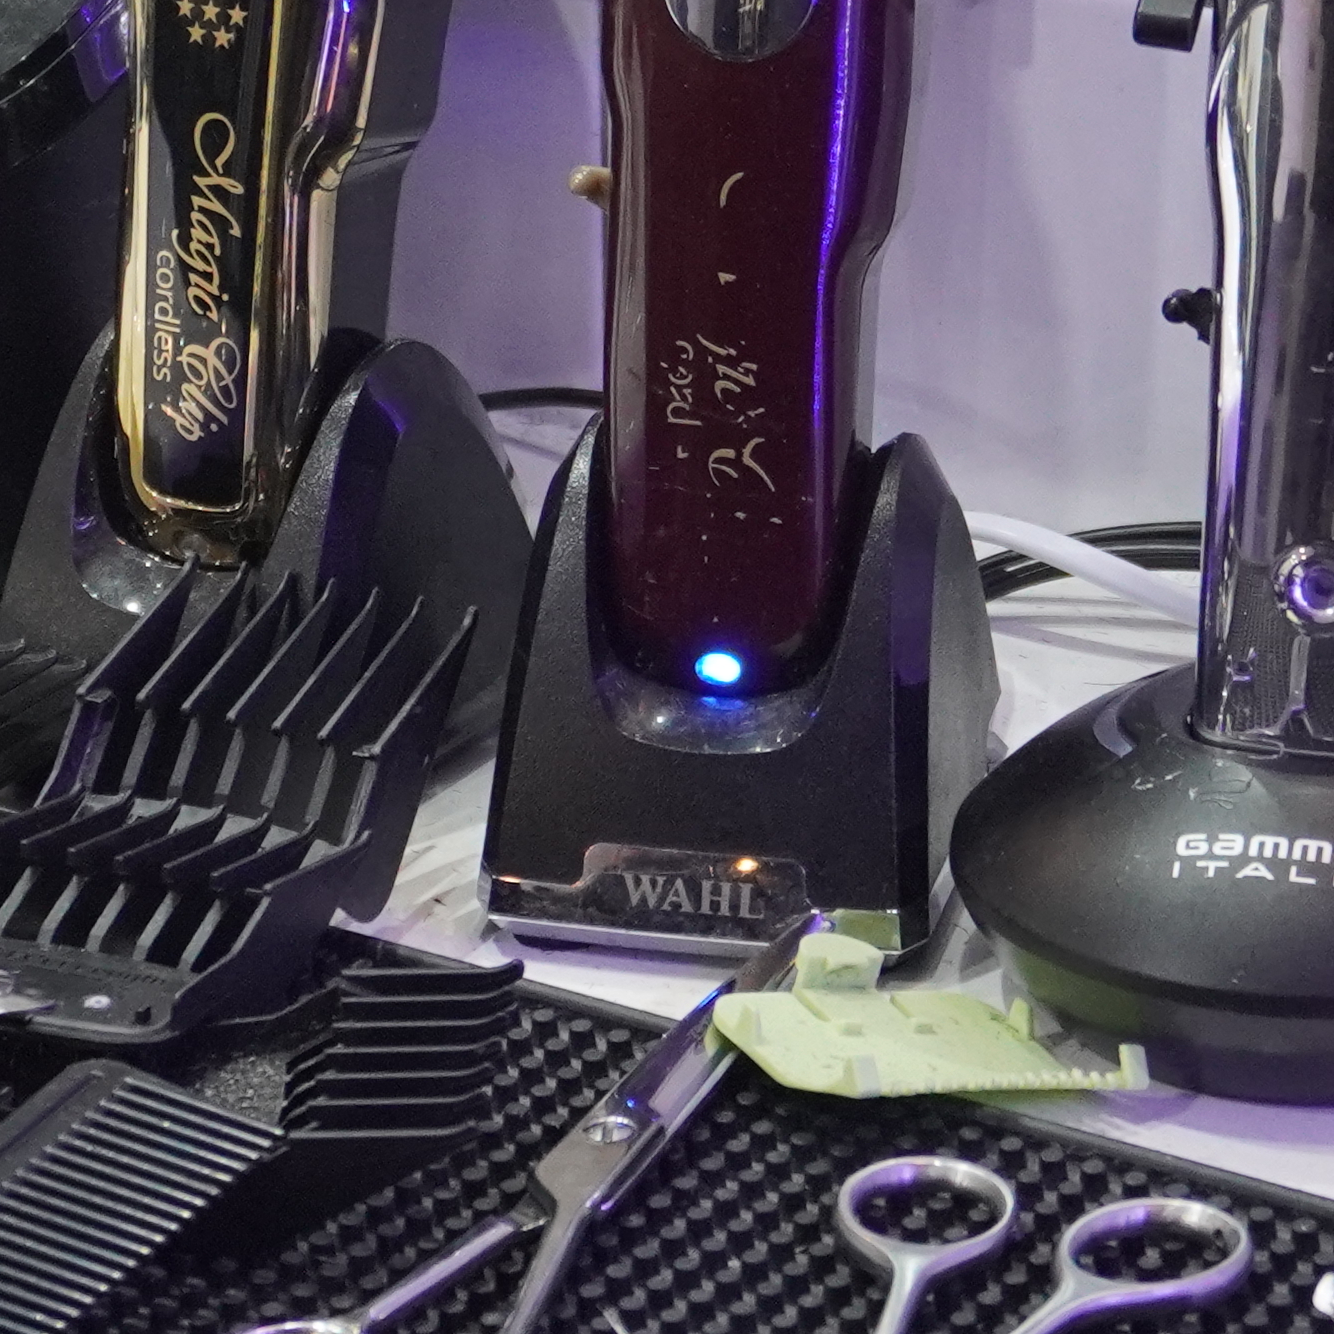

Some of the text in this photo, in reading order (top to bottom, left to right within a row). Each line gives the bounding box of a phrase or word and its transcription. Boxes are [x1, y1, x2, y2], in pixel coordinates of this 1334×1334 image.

[152, 250, 181, 383] cordless
[161, 111, 245, 443] Magic Clip
[623, 873, 765, 919] WAHL
